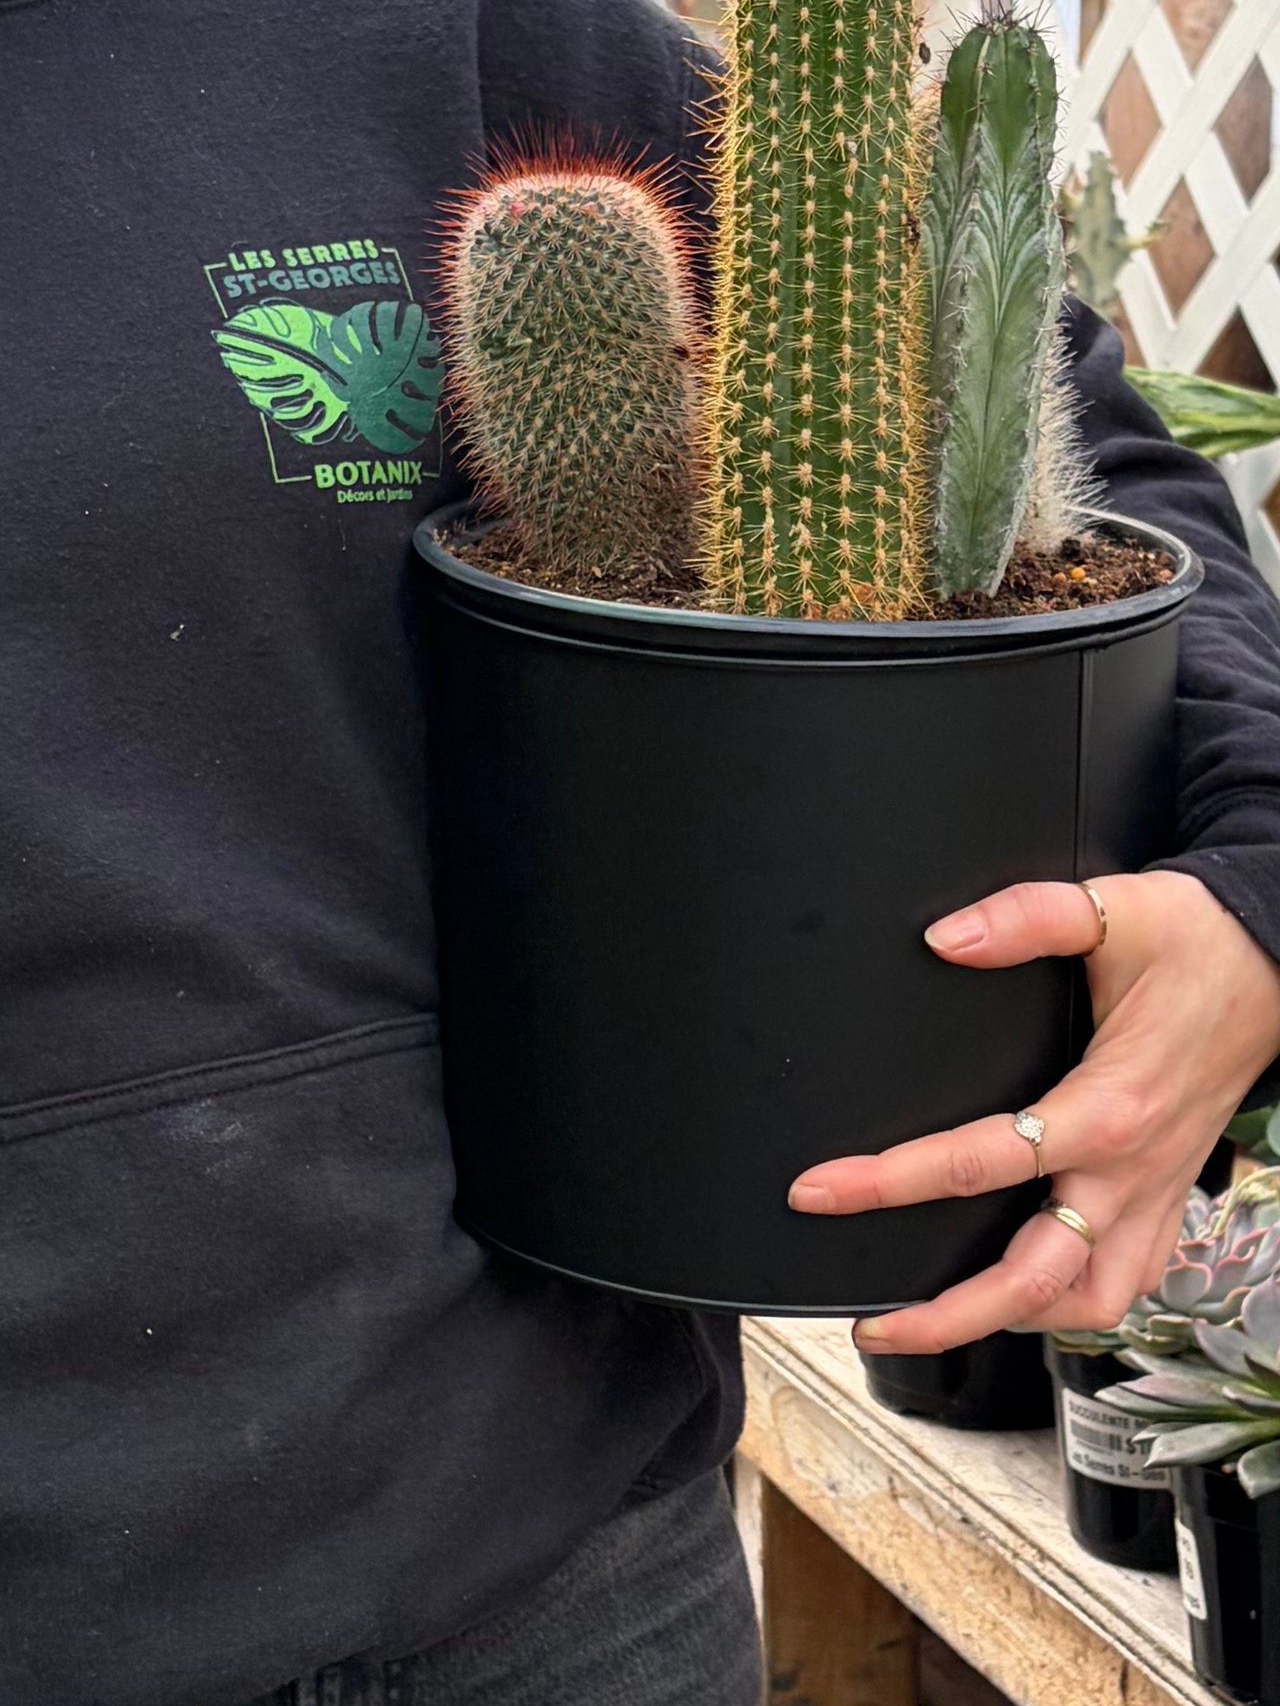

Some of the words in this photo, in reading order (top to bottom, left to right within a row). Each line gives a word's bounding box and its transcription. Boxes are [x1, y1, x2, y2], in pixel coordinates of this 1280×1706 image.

[227, 248, 276, 273] LES
[281, 238, 379, 268] SERRES
[222, 260, 401, 299] ST-GEORGES
[314, 460, 423, 489] BOTANIX
